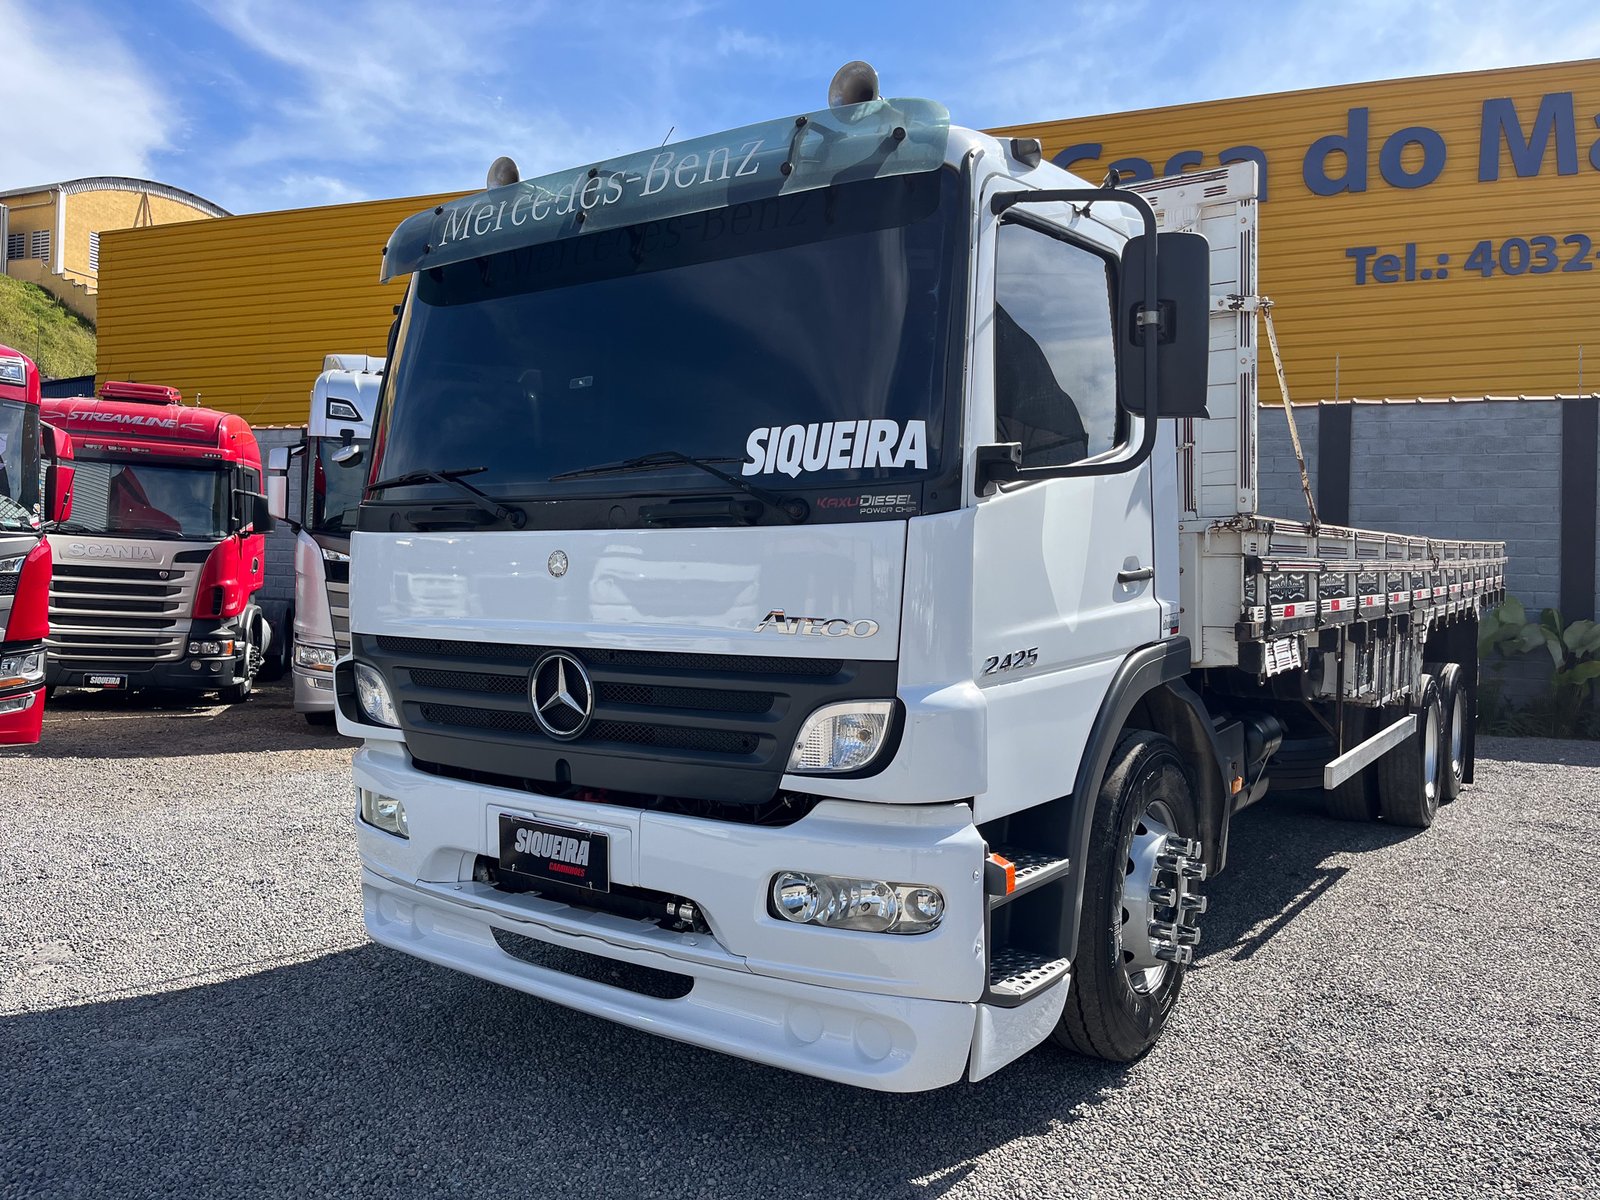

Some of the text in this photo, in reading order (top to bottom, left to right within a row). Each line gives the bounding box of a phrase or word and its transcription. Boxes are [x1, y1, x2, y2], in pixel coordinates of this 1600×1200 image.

[1302, 106, 1447, 197] do
[1477, 91, 1600, 186] M
[438, 138, 765, 248] Mercedes-Benz
[1345, 242, 1450, 286] Tel.:
[67, 411, 179, 428] STREAMLINE
[741, 419, 928, 479] SIQUEIRA
[860, 506, 893, 514] POWER
[68, 543, 156, 561] SCANIA
[983, 647, 1039, 676] 2425
[90, 676, 121, 685] SIQUEIRA
[514, 828, 590, 867] SIQUEIRA
